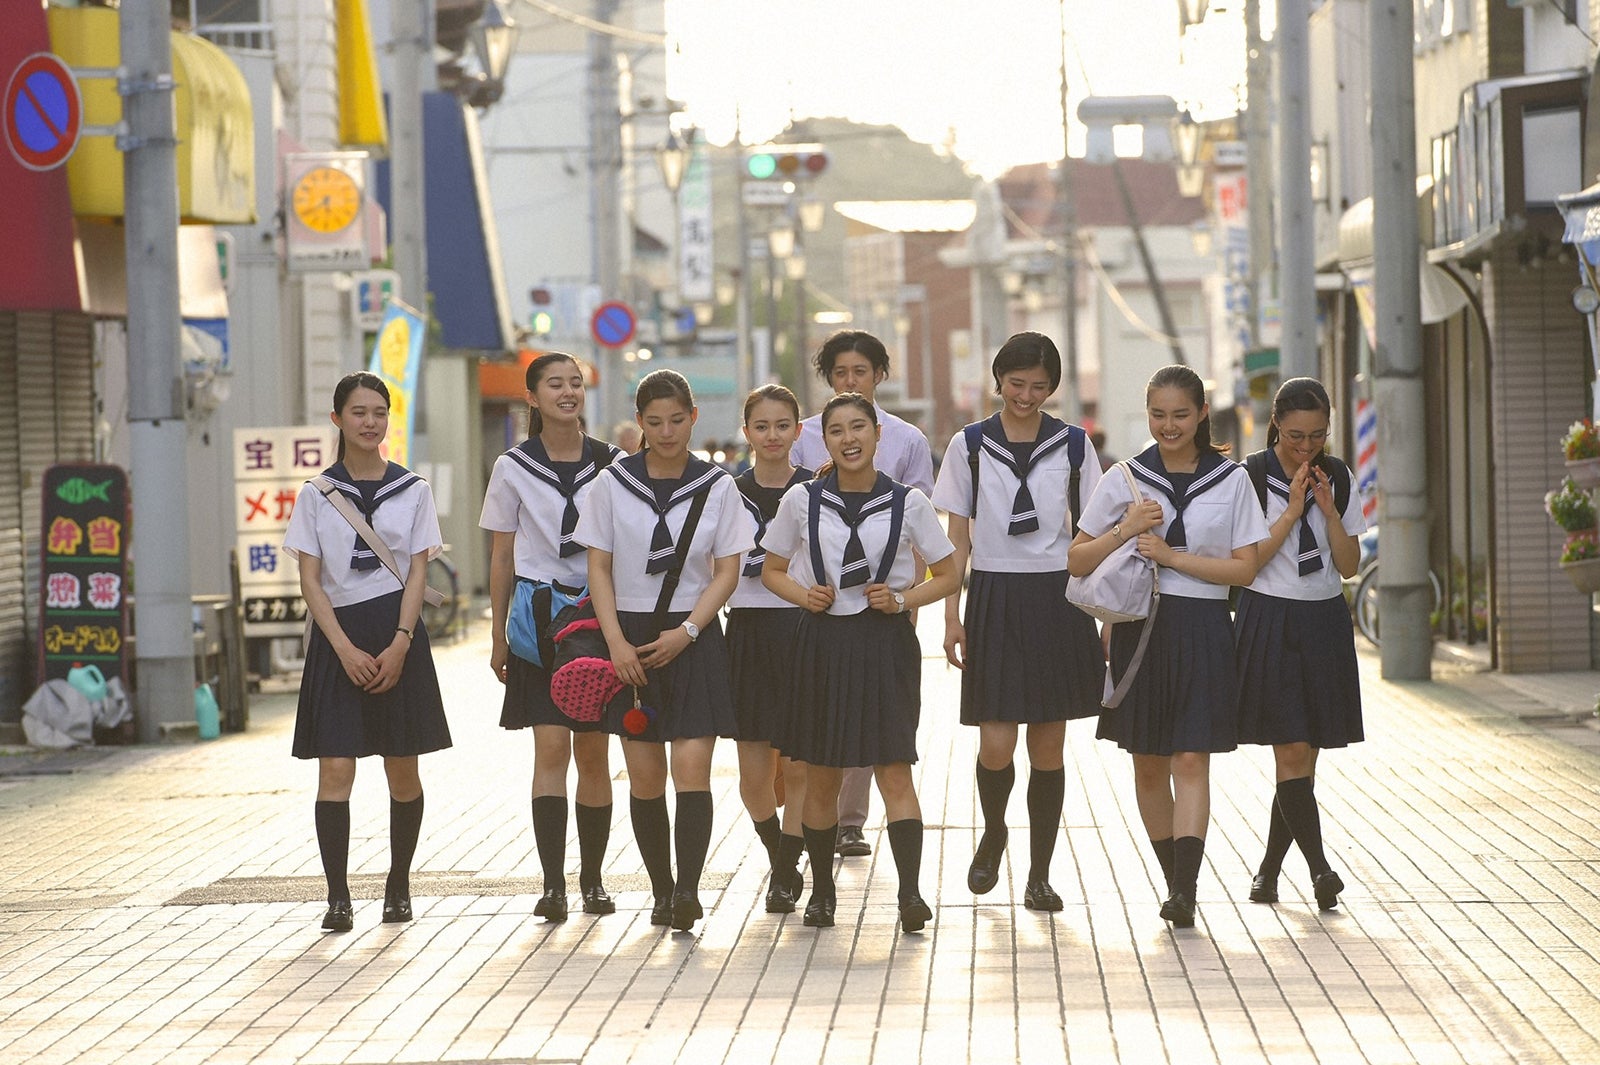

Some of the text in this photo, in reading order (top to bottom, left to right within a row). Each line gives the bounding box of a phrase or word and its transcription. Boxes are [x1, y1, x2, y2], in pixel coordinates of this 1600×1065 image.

[245, 440, 321, 470] 宝石
[246, 490, 296, 521] メガ
[48, 516, 121, 555] 弁当
[250, 544, 278, 573] 時
[47, 572, 121, 609] 惣菜
